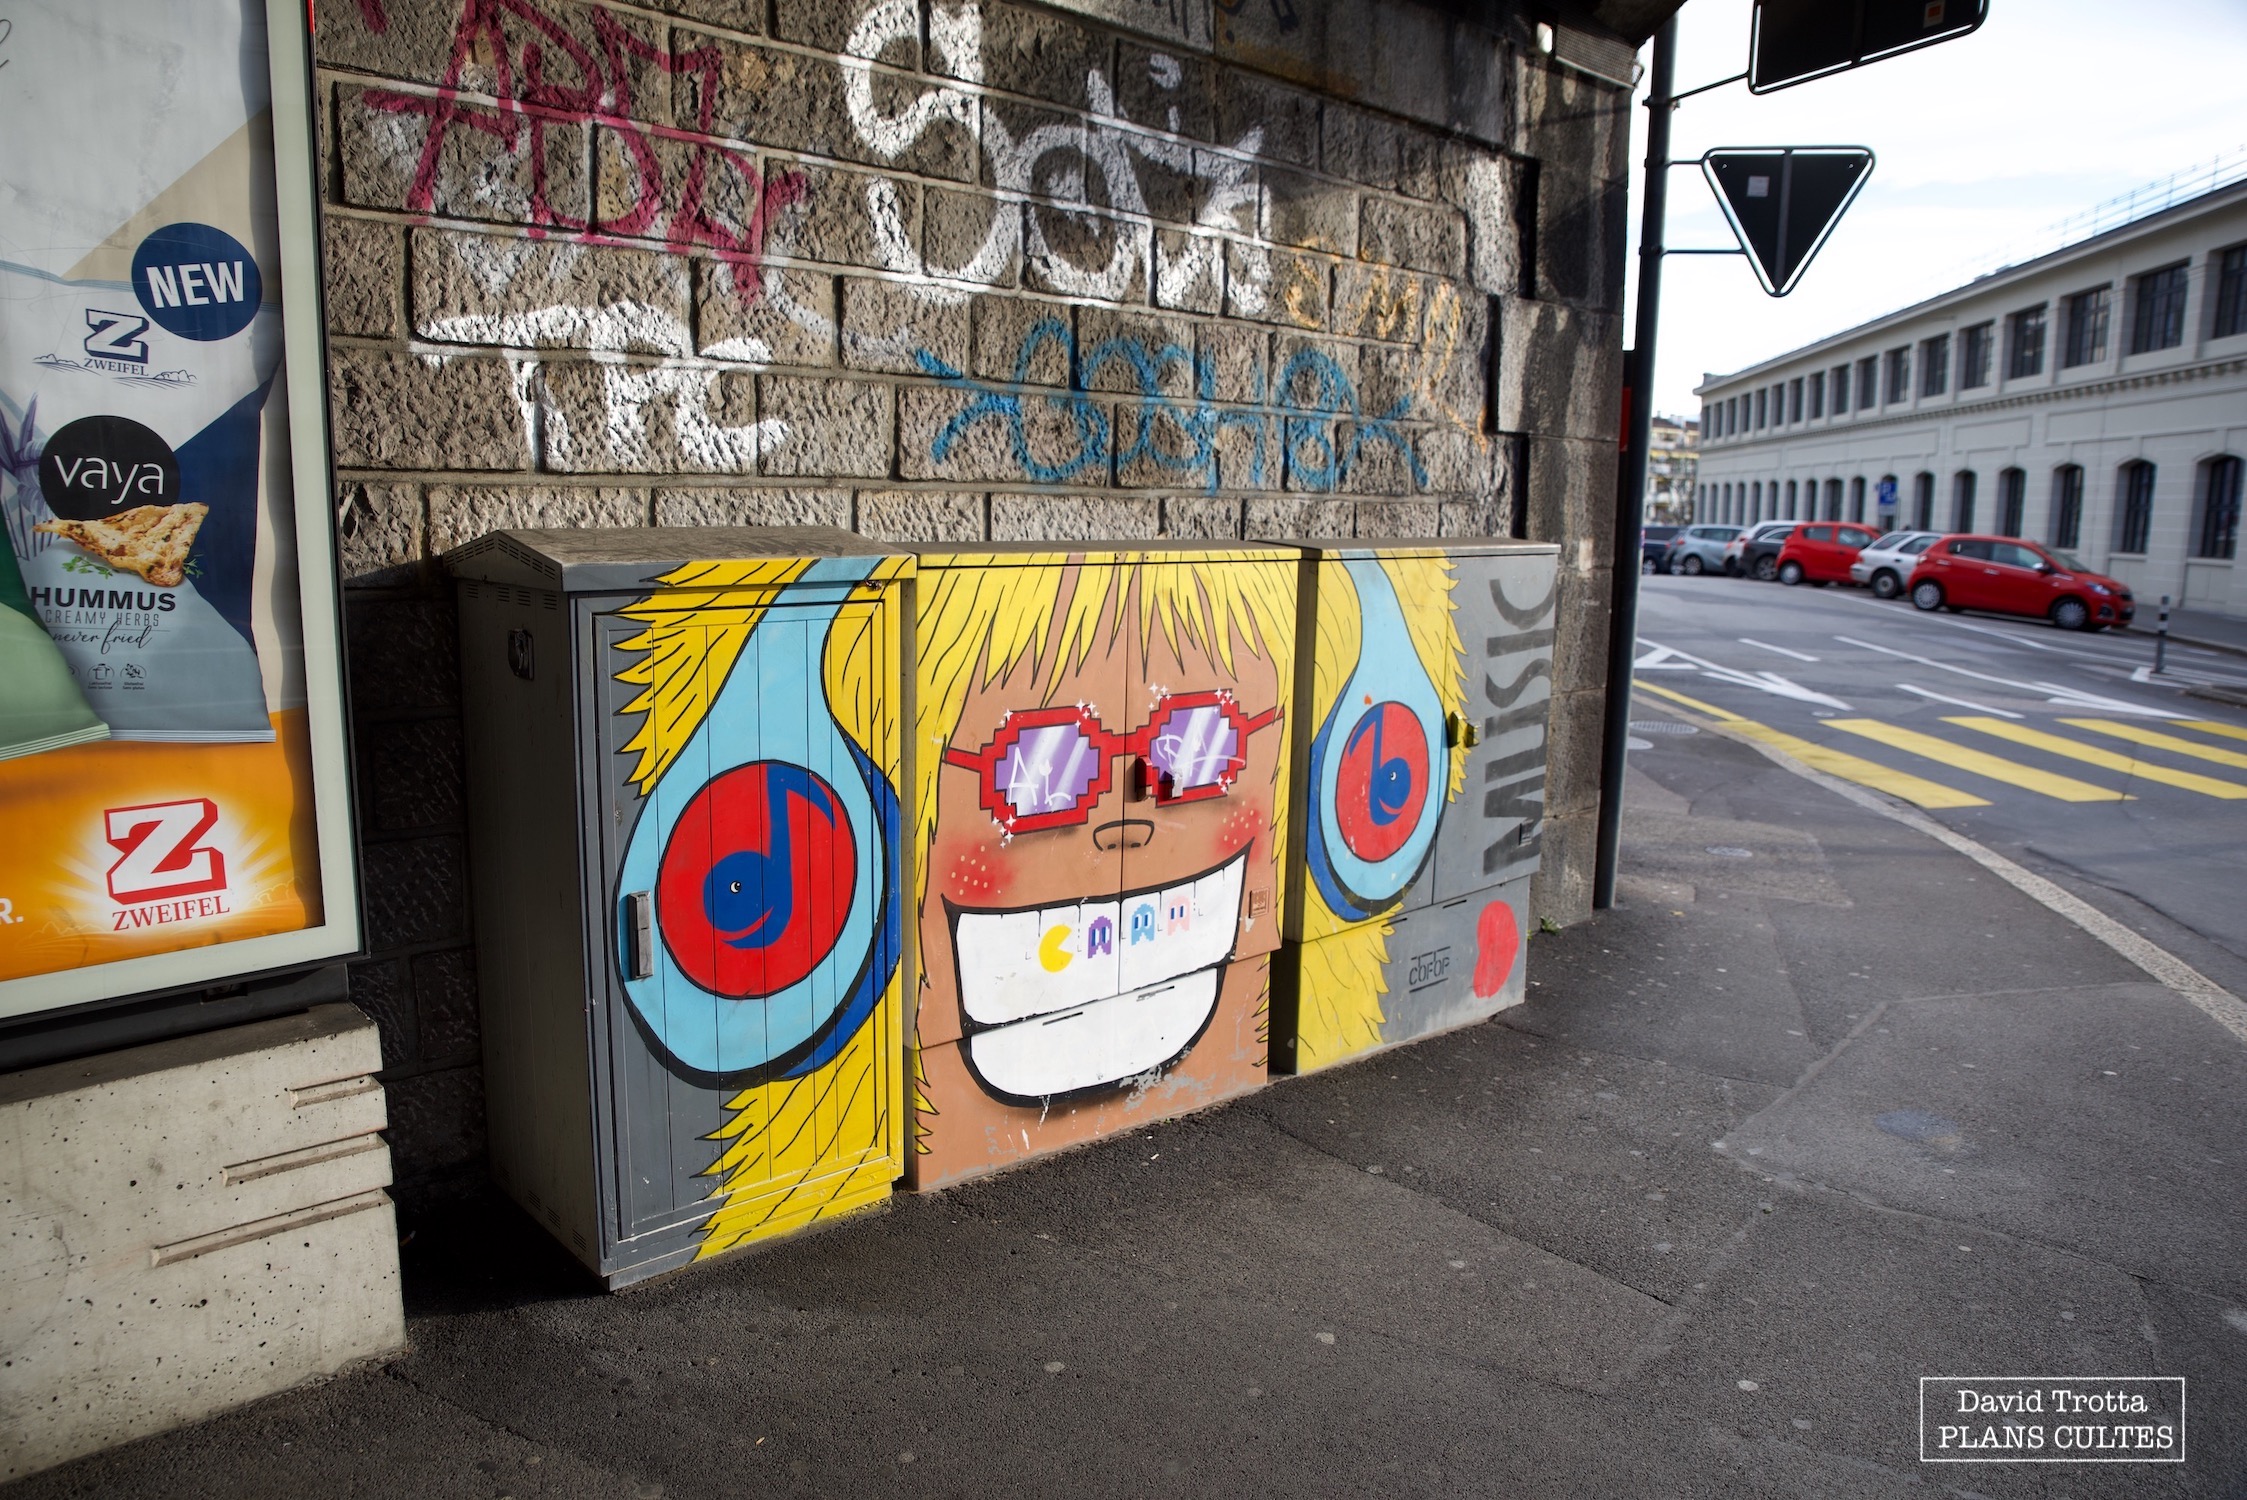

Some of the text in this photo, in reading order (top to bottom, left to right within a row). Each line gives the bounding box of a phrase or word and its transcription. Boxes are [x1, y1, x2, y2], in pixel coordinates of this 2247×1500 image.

[146, 261, 244, 308] NEW
[84, 357, 150, 377] ZWEIFEL
[54, 454, 165, 505] vaya
[31, 586, 176, 612] HUMMUS
[45, 609, 160, 627] CREAMY HERBS
[52, 620, 153, 655] never fried
[1483, 578, 1556, 876] MUSIC
[112, 895, 231, 931] ZWEIFEL
